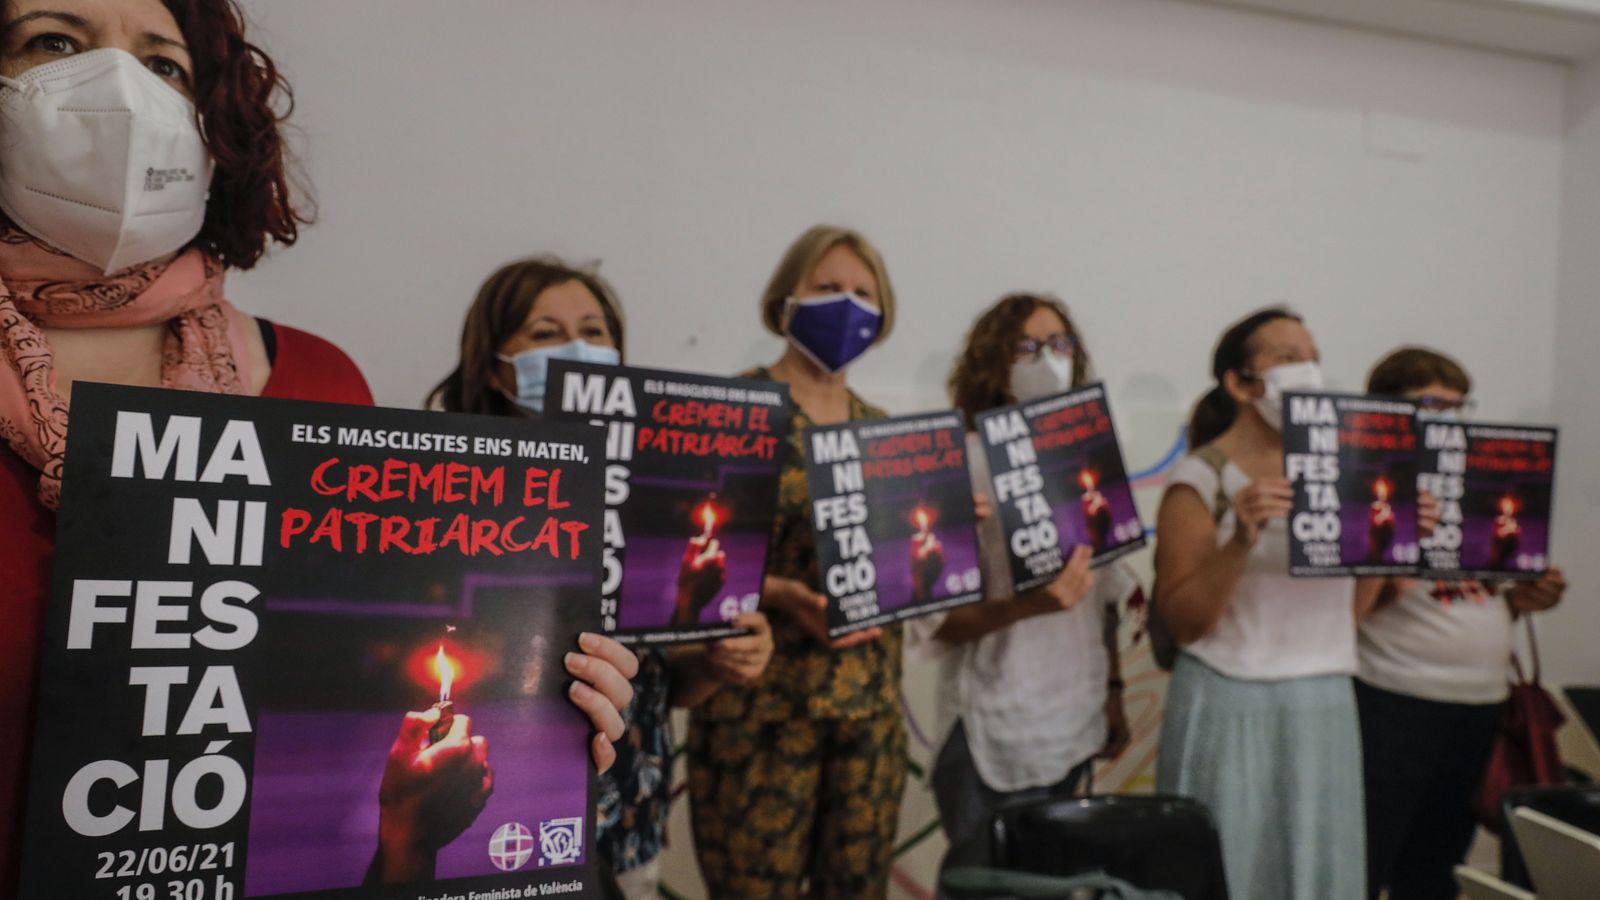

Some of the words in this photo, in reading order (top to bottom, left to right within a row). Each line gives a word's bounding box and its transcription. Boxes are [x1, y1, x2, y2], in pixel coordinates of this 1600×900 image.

[561, 371, 637, 417] MA
[1289, 396, 1338, 425] MA
[652, 400, 743, 429] CREMEM
[748, 406, 770, 432] EL
[984, 410, 1031, 445] MA
[111, 411, 272, 486] MA
[291, 424, 331, 444] ELS
[337, 427, 468, 453] MASCLISTES
[473, 437, 512, 457] ENS
[517, 440, 589, 464] MATEN,
[638, 427, 779, 460] PATRIARCAT
[812, 428, 861, 464] MA
[1006, 437, 1037, 468] NI
[1308, 425, 1339, 454] NI
[1424, 423, 1468, 450] MA
[310, 457, 505, 508] CREMEM
[523, 466, 570, 510] EL
[832, 460, 864, 494] NI
[993, 464, 1044, 503] FES
[1285, 453, 1340, 481] FES
[813, 492, 868, 531] FES
[1014, 492, 1053, 524] TA
[1304, 482, 1341, 512] TA
[168, 497, 267, 566] NI
[280, 507, 590, 560] PATRIARCAT
[833, 525, 873, 559] TA
[826, 553, 876, 597] CIÓ
[66, 579, 261, 650] FES
[128, 665, 252, 736] TA
[62, 740, 247, 837] CIÓ
[95, 842, 235, 879] 22/06/21
[215, 875, 234, 900] h
[524, 884, 538, 898] de
